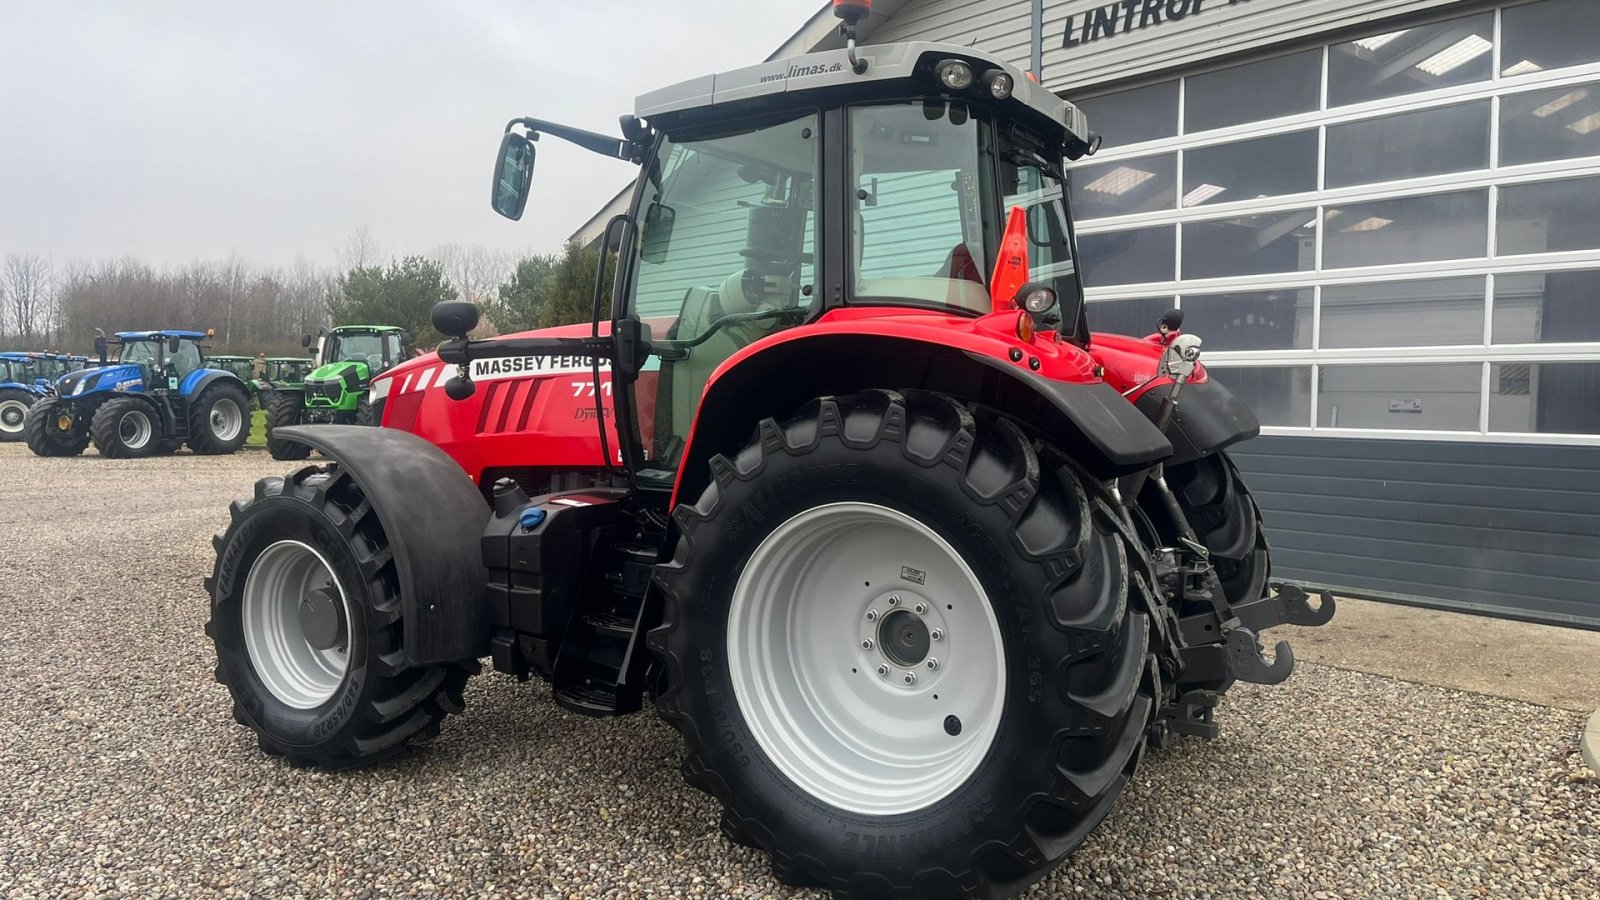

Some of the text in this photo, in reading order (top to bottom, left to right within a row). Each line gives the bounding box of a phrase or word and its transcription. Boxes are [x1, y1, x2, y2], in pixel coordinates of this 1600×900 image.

[760, 62, 842, 83] www.limas.dk
[476, 354, 612, 376] MASSEY FERGU
[571, 381, 612, 397] 771
[313, 677, 360, 738] 540/65R28
